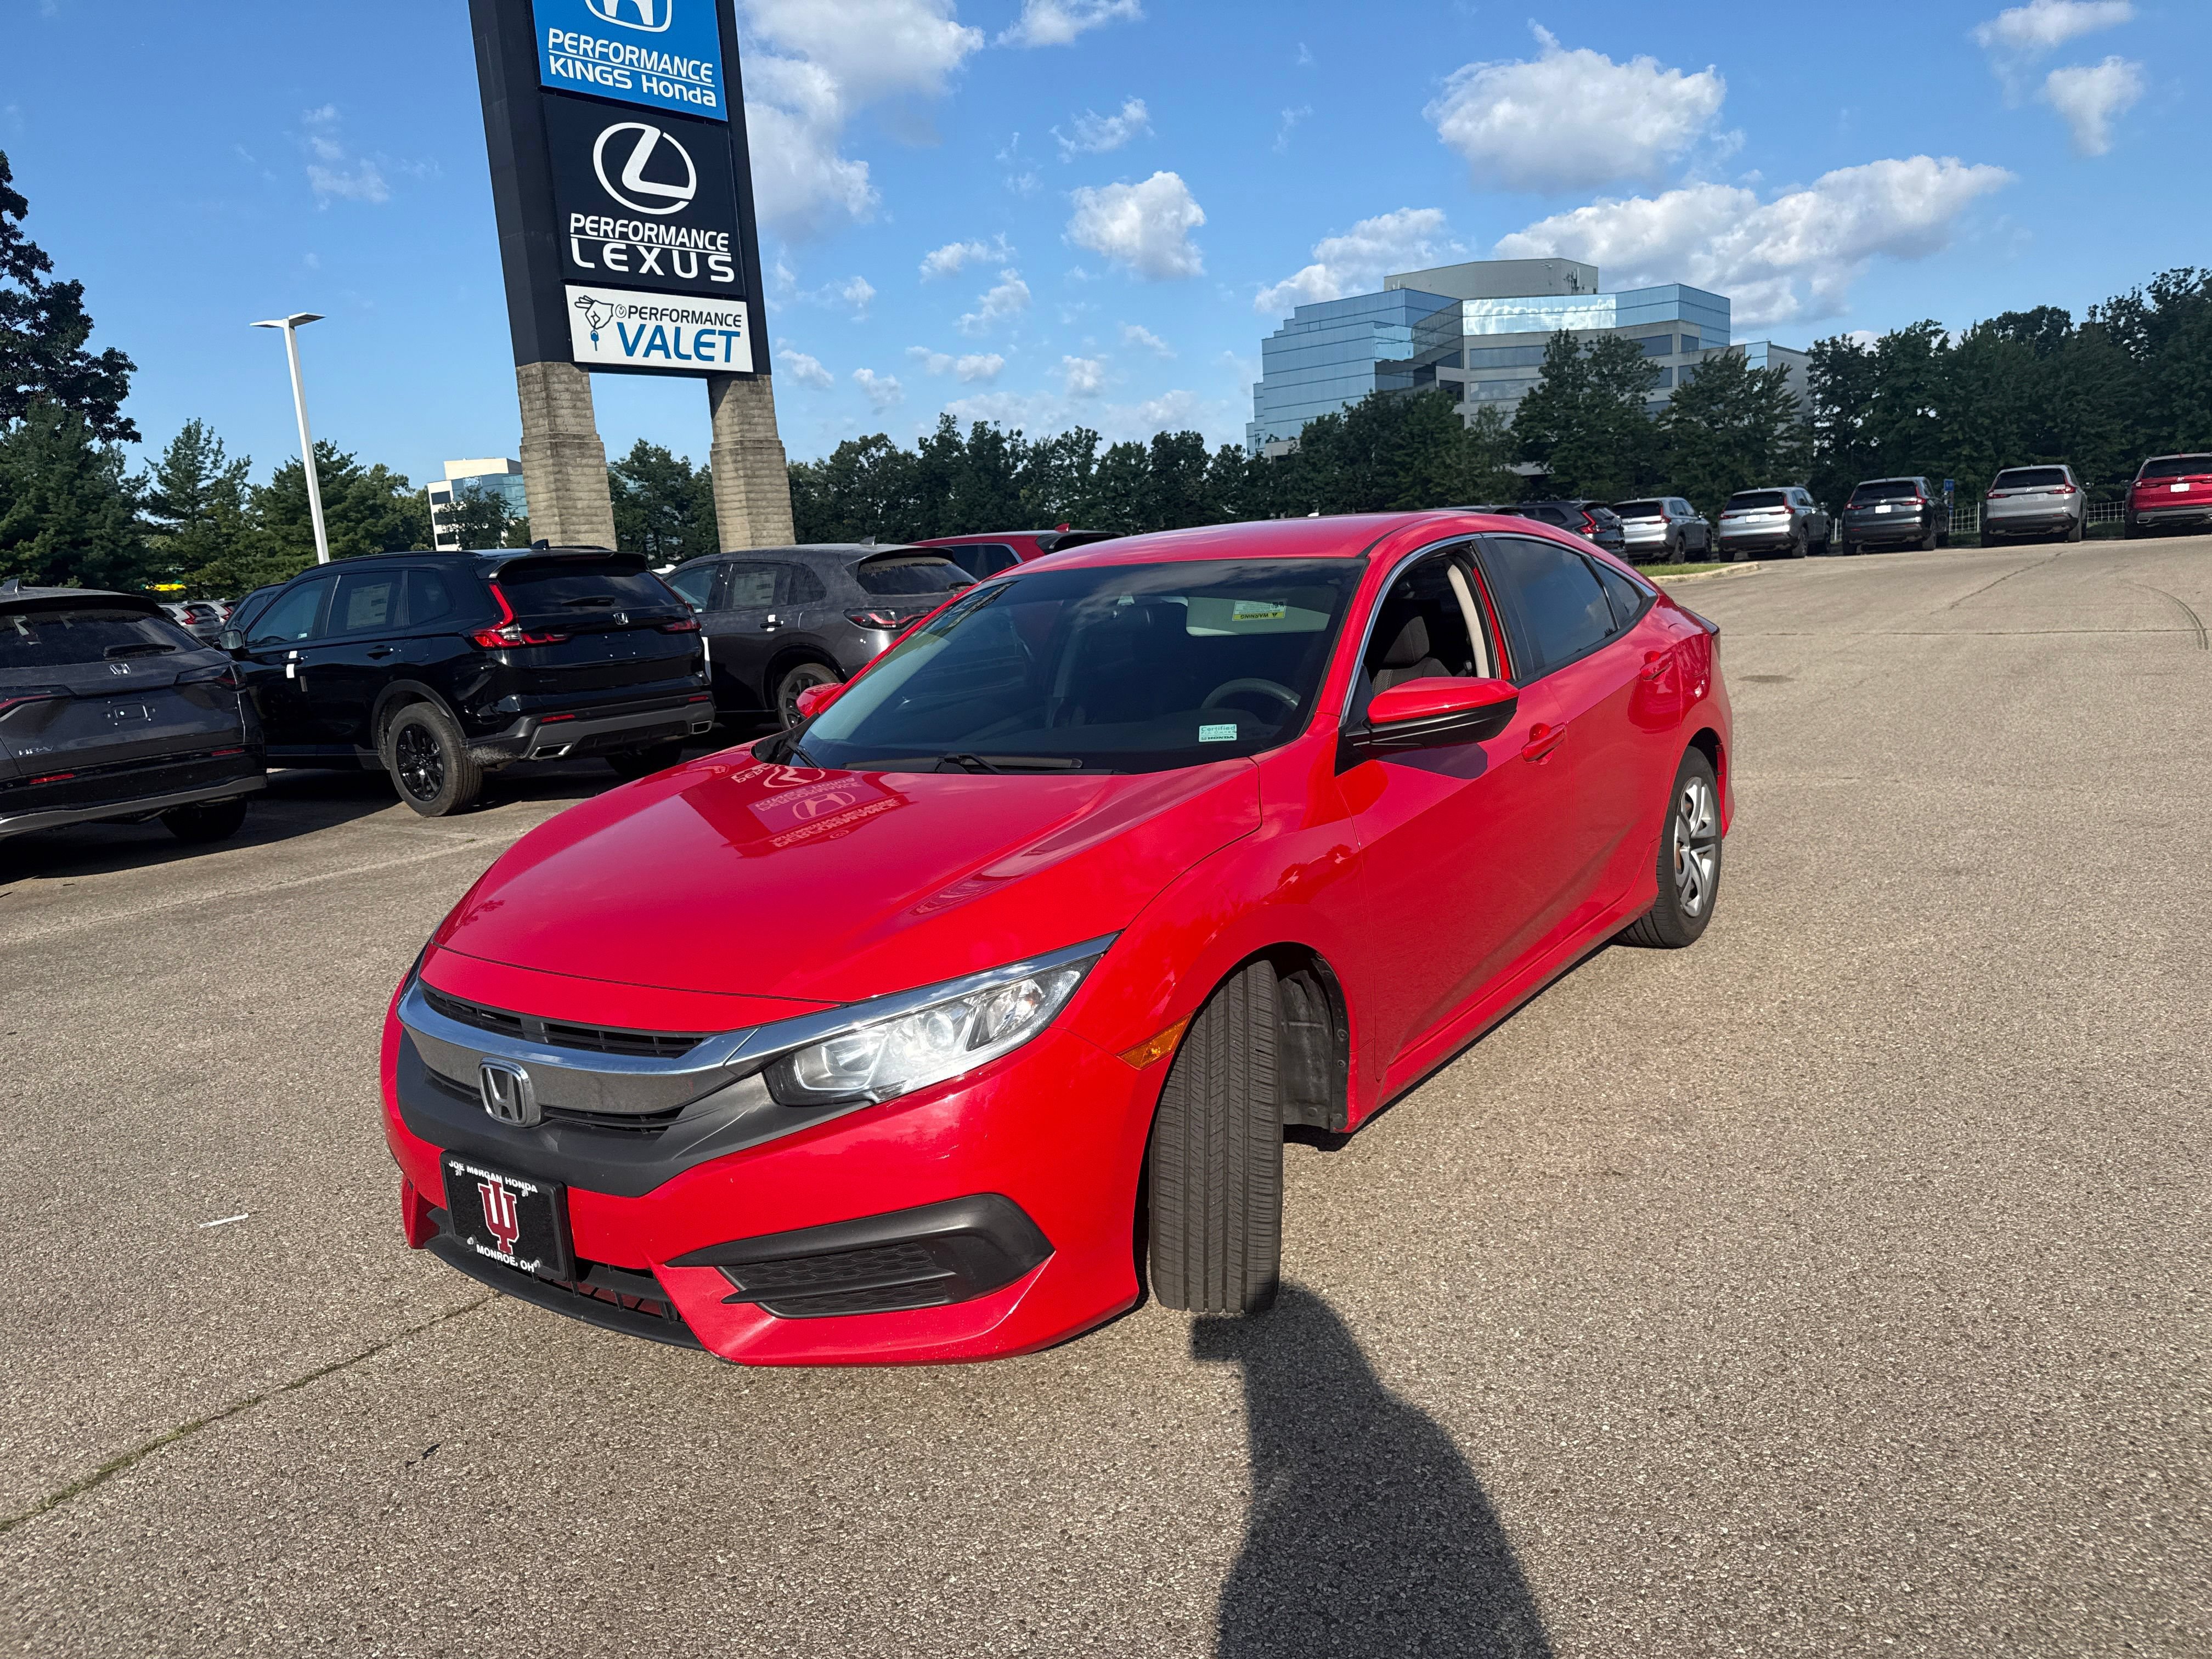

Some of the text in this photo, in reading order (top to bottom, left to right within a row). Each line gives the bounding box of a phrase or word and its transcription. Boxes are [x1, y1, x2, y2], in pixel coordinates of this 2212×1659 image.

[549, 27, 713, 83] PERFORMANCE
[549, 55, 716, 107] KINGS Honda
[571, 213, 729, 252] PERFORMANCE
[571, 238, 734, 283] LEXUS
[628, 305, 742, 328] PERFORMANCE
[617, 322, 741, 363] VALET
[449, 1160, 538, 1193] JOE MORGAN HONDA
[476, 1244, 535, 1272] MONROE, OH
